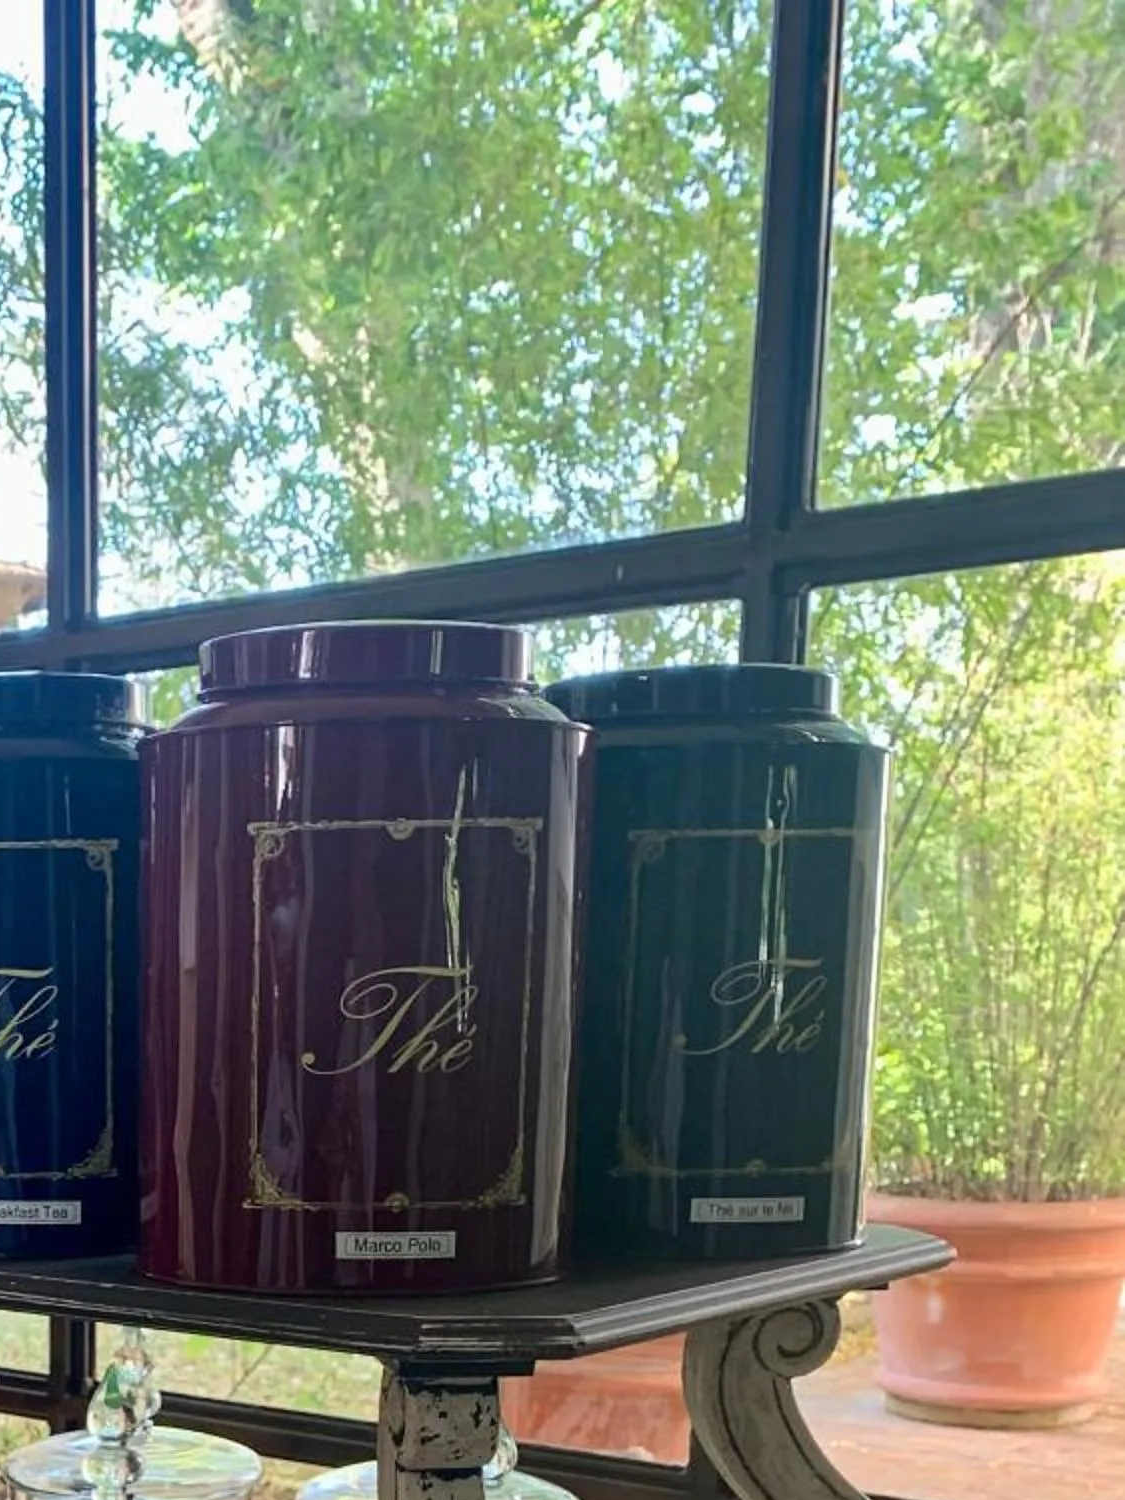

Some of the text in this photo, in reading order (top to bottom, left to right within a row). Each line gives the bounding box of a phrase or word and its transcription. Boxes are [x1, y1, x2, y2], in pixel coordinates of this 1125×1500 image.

[301, 963, 479, 1075] Thé
[676, 957, 827, 1057] Thé
[43, 1205, 68, 1219] Tea
[354, 1236, 442, 1253] Marco Polo
